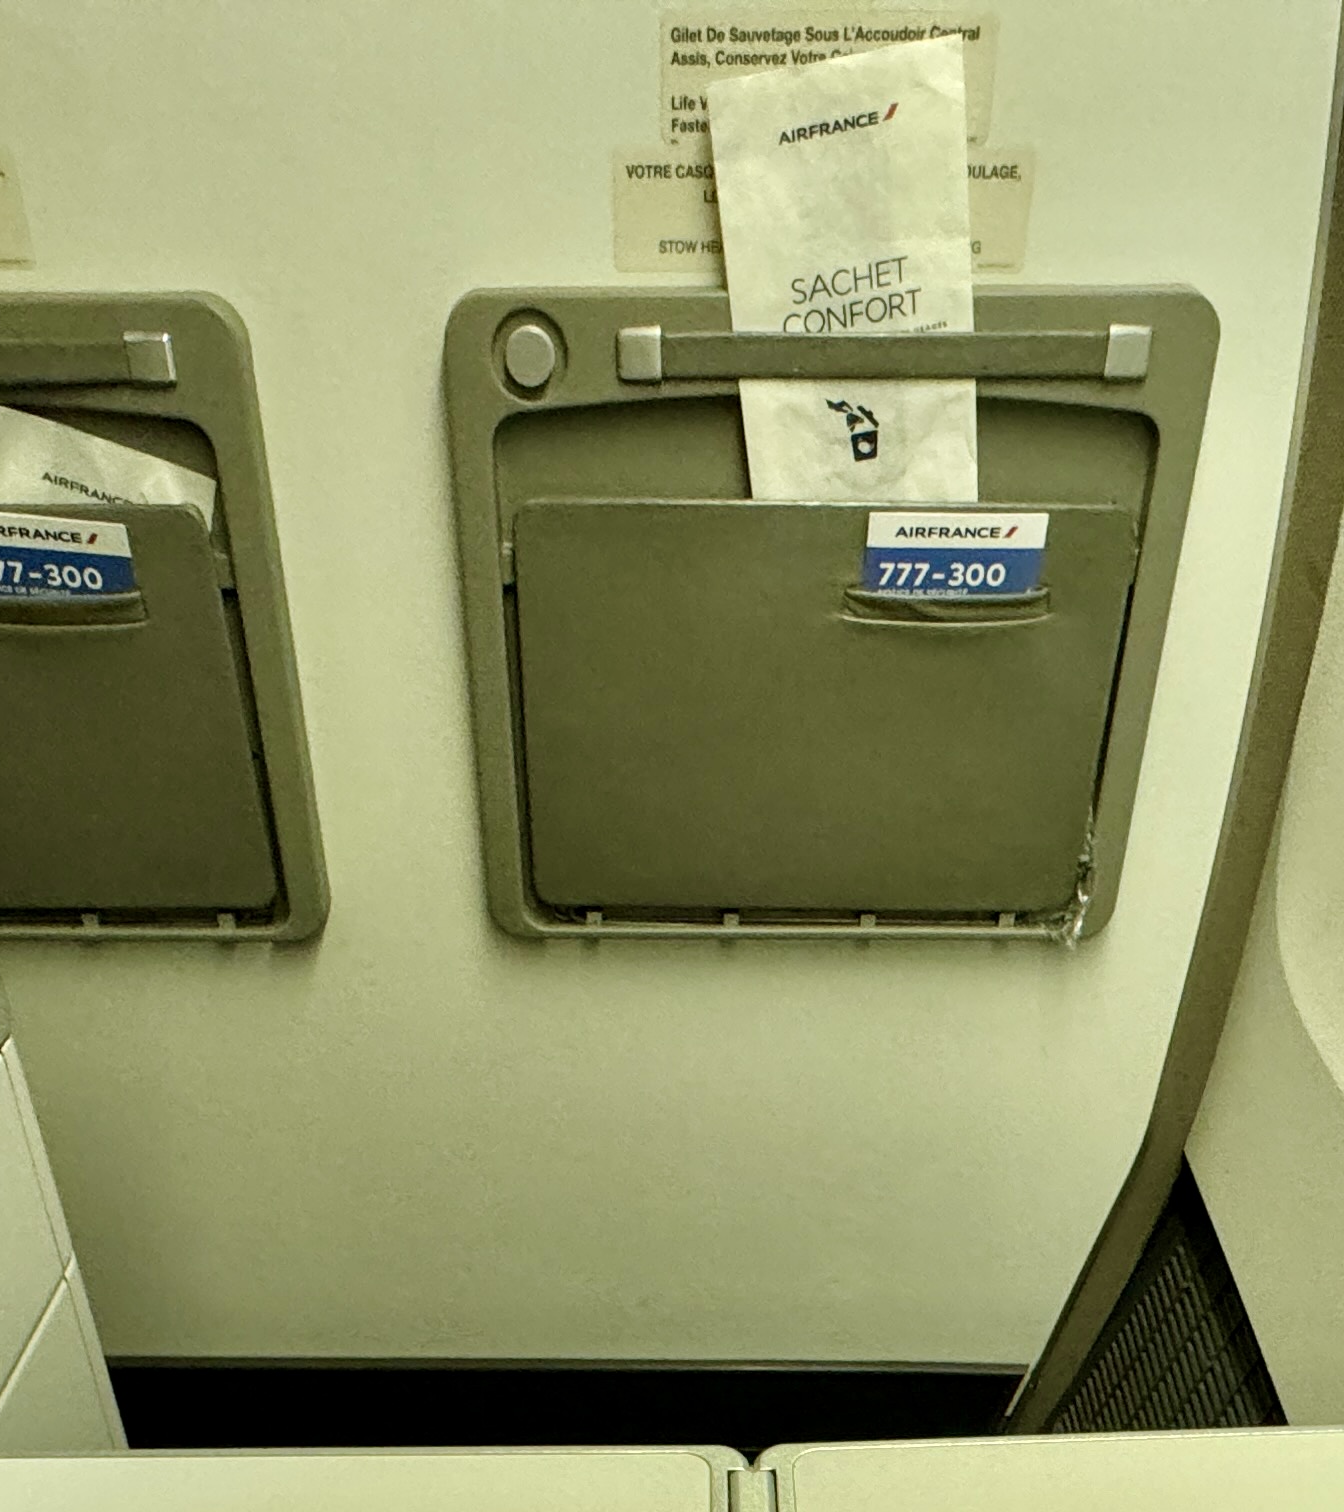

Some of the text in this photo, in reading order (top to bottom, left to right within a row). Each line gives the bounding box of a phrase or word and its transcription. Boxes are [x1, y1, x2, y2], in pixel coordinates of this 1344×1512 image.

[671, 27, 702, 43] Gilet
[707, 27, 725, 42] De
[729, 27, 801, 46] Sauvetage
[805, 26, 839, 42] Sous
[843, 26, 926, 42] L'Accoudoir
[671, 51, 710, 68] Assis,
[716, 50, 787, 66] Conservez
[791, 49, 827, 65] Votre
[671, 94, 696, 111] Life
[671, 118, 709, 133] Faste
[779, 111, 879, 146] AIRFRANCE
[625, 164, 672, 179] VOTRE
[675, 164, 714, 180] CASQ
[659, 240, 698, 254] STOW
[791, 256, 908, 305] SACHET
[783, 287, 922, 333] CONFORT
[895, 526, 1001, 538] AIRFRANCE
[879, 562, 1006, 587] 777-300
